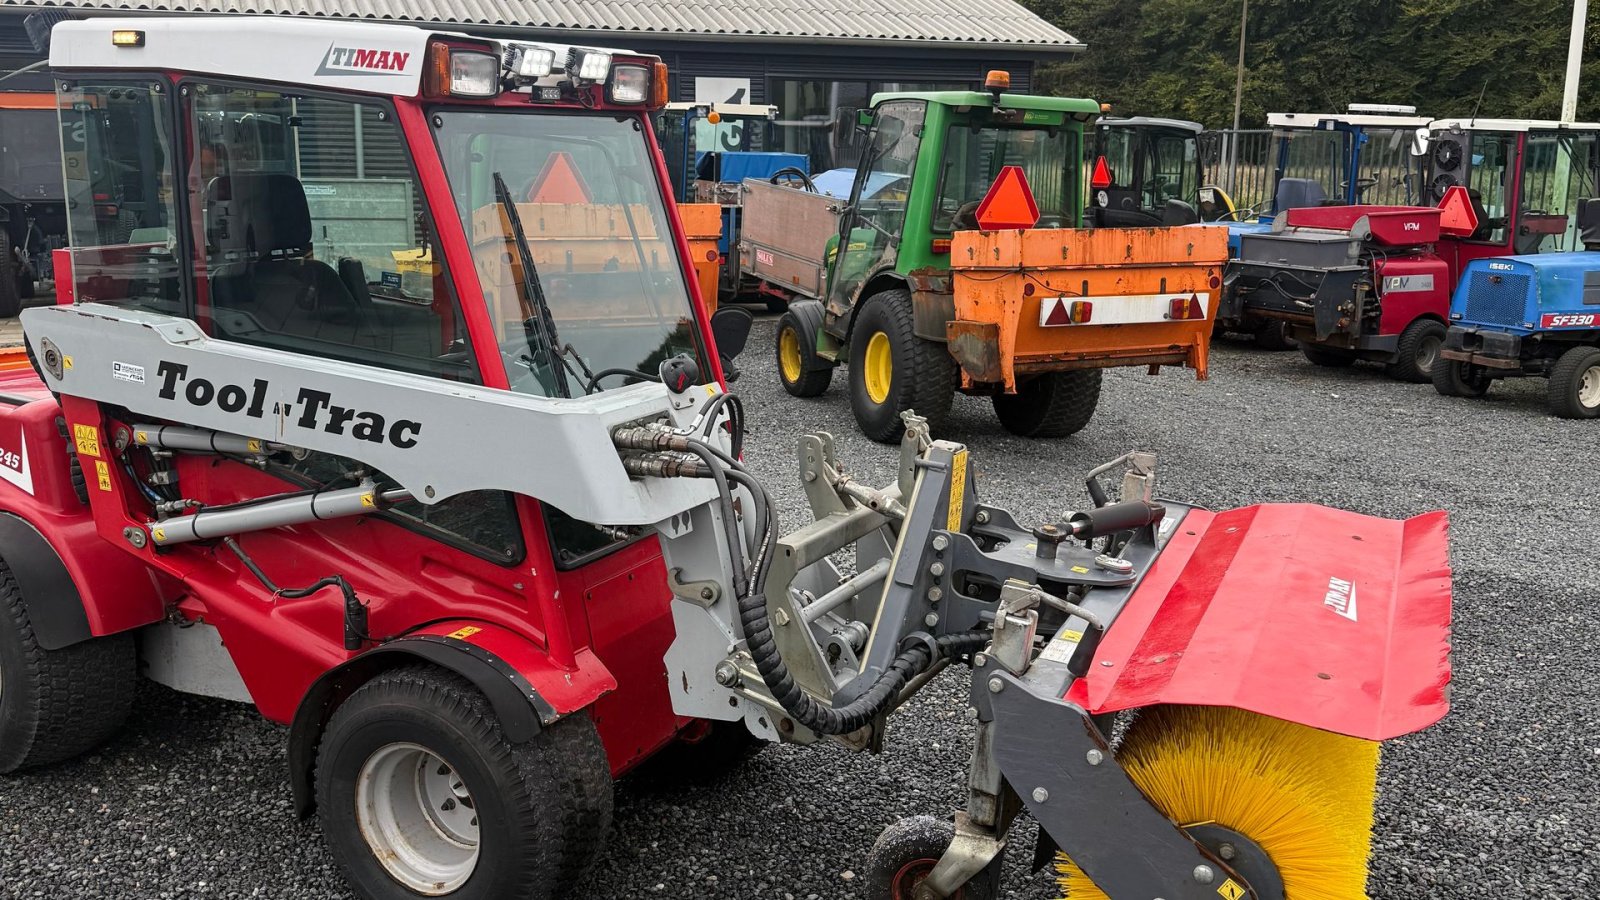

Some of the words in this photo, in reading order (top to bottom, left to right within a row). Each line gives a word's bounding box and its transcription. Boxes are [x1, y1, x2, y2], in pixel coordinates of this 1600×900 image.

[332, 47, 410, 71] TIMAN
[1403, 222, 1420, 231] VPM
[1489, 262, 1514, 271] ISEKI
[1549, 315, 1595, 326] SF330
